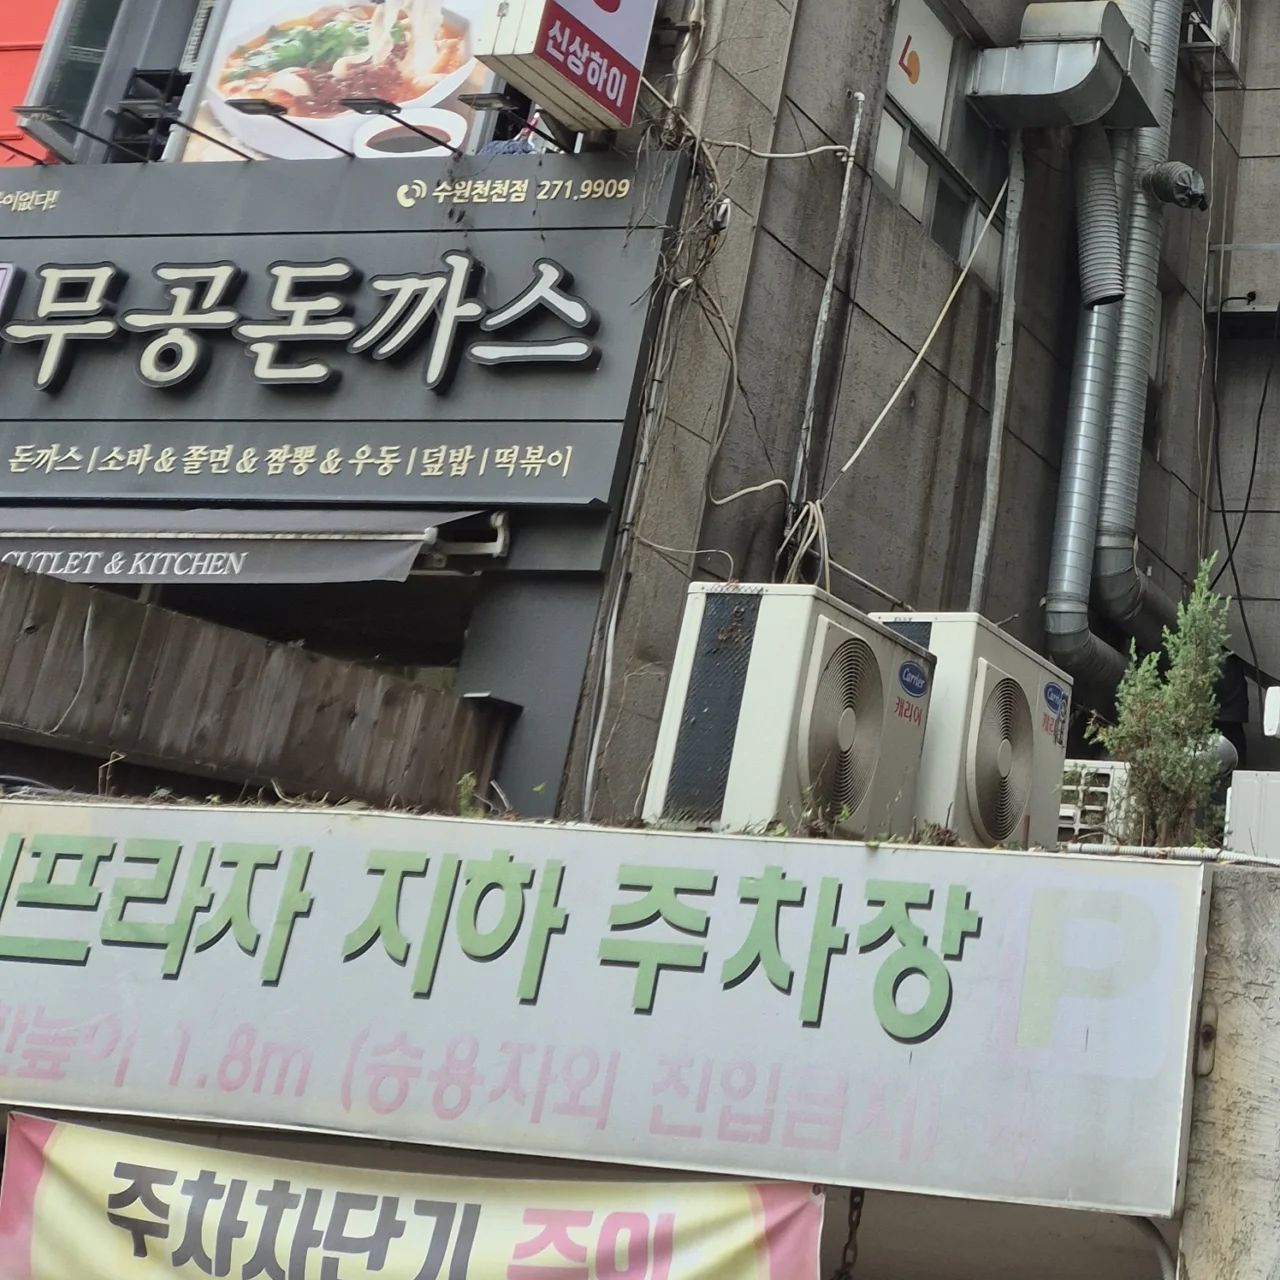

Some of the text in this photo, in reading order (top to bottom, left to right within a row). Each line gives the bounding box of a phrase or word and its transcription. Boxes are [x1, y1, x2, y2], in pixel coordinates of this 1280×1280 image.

[546, 20, 627, 108] 신상하이
[0, 190, 60, 211] 이없다!
[432, 178, 631, 204] 수원천천점 271.9909
[3, 251, 597, 388] 무공돈까스
[7, 444, 84, 475] 돈까스
[98, 444, 154, 475] 소바
[183, 444, 231, 475] 쫄면
[264, 444, 316, 476] 짬뽕
[347, 444, 402, 477] 우동
[420, 444, 475, 478] 덮밥
[494, 444, 574, 479] 떡볶이
[128, 552, 249, 575] KITCHEN
[894, 696, 923, 727] 캐리어
[0, 833, 315, 987] 프라자
[343, 849, 569, 1005] 지하
[598, 864, 982, 1044] 주차장
[169, 1022, 313, 1098] 1.8m
[106, 1161, 482, 1280] 주차차단기
